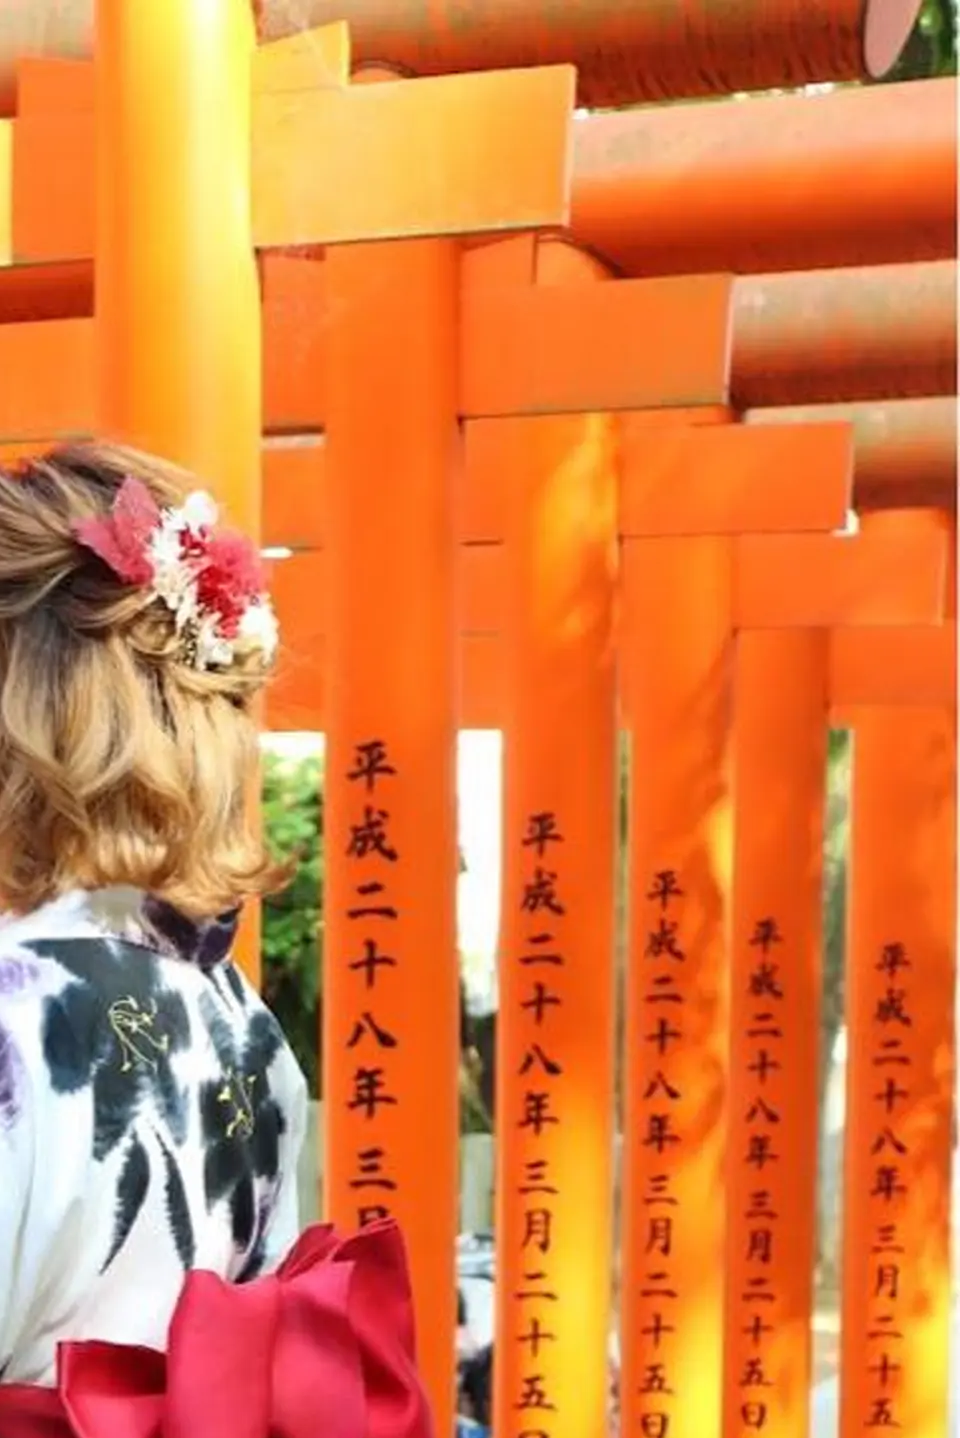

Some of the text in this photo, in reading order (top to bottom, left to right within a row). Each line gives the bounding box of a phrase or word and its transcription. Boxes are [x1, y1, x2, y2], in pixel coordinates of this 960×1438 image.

[739, 916, 784, 1430] 平成二十八年三月二十五日
